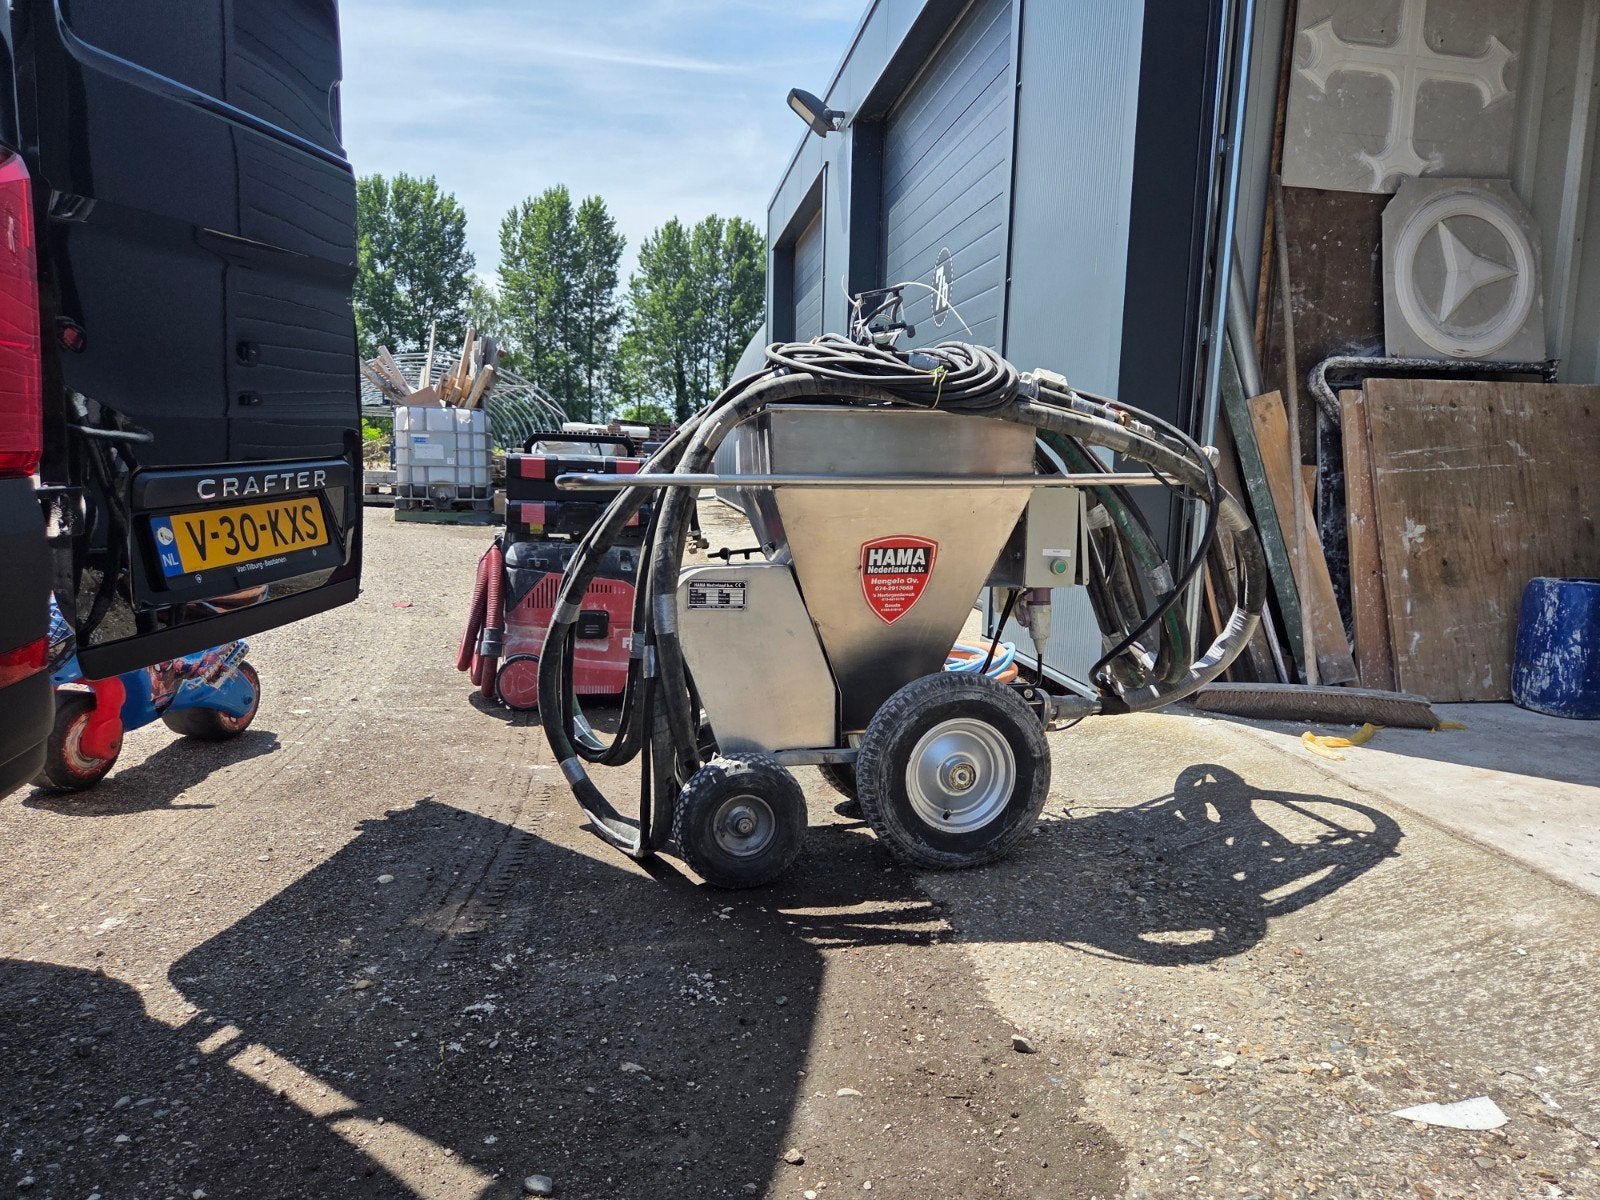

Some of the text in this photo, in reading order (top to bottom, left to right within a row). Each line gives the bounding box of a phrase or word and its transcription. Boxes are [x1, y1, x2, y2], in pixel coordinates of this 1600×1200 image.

[197, 470, 327, 499] CRAFTER
[184, 504, 319, 562] V-30-KXS
[161, 552, 180, 568] NL
[868, 548, 926, 566] HAMA
[867, 565, 910, 574] Nederland
[871, 577, 905, 585] Hengelo
